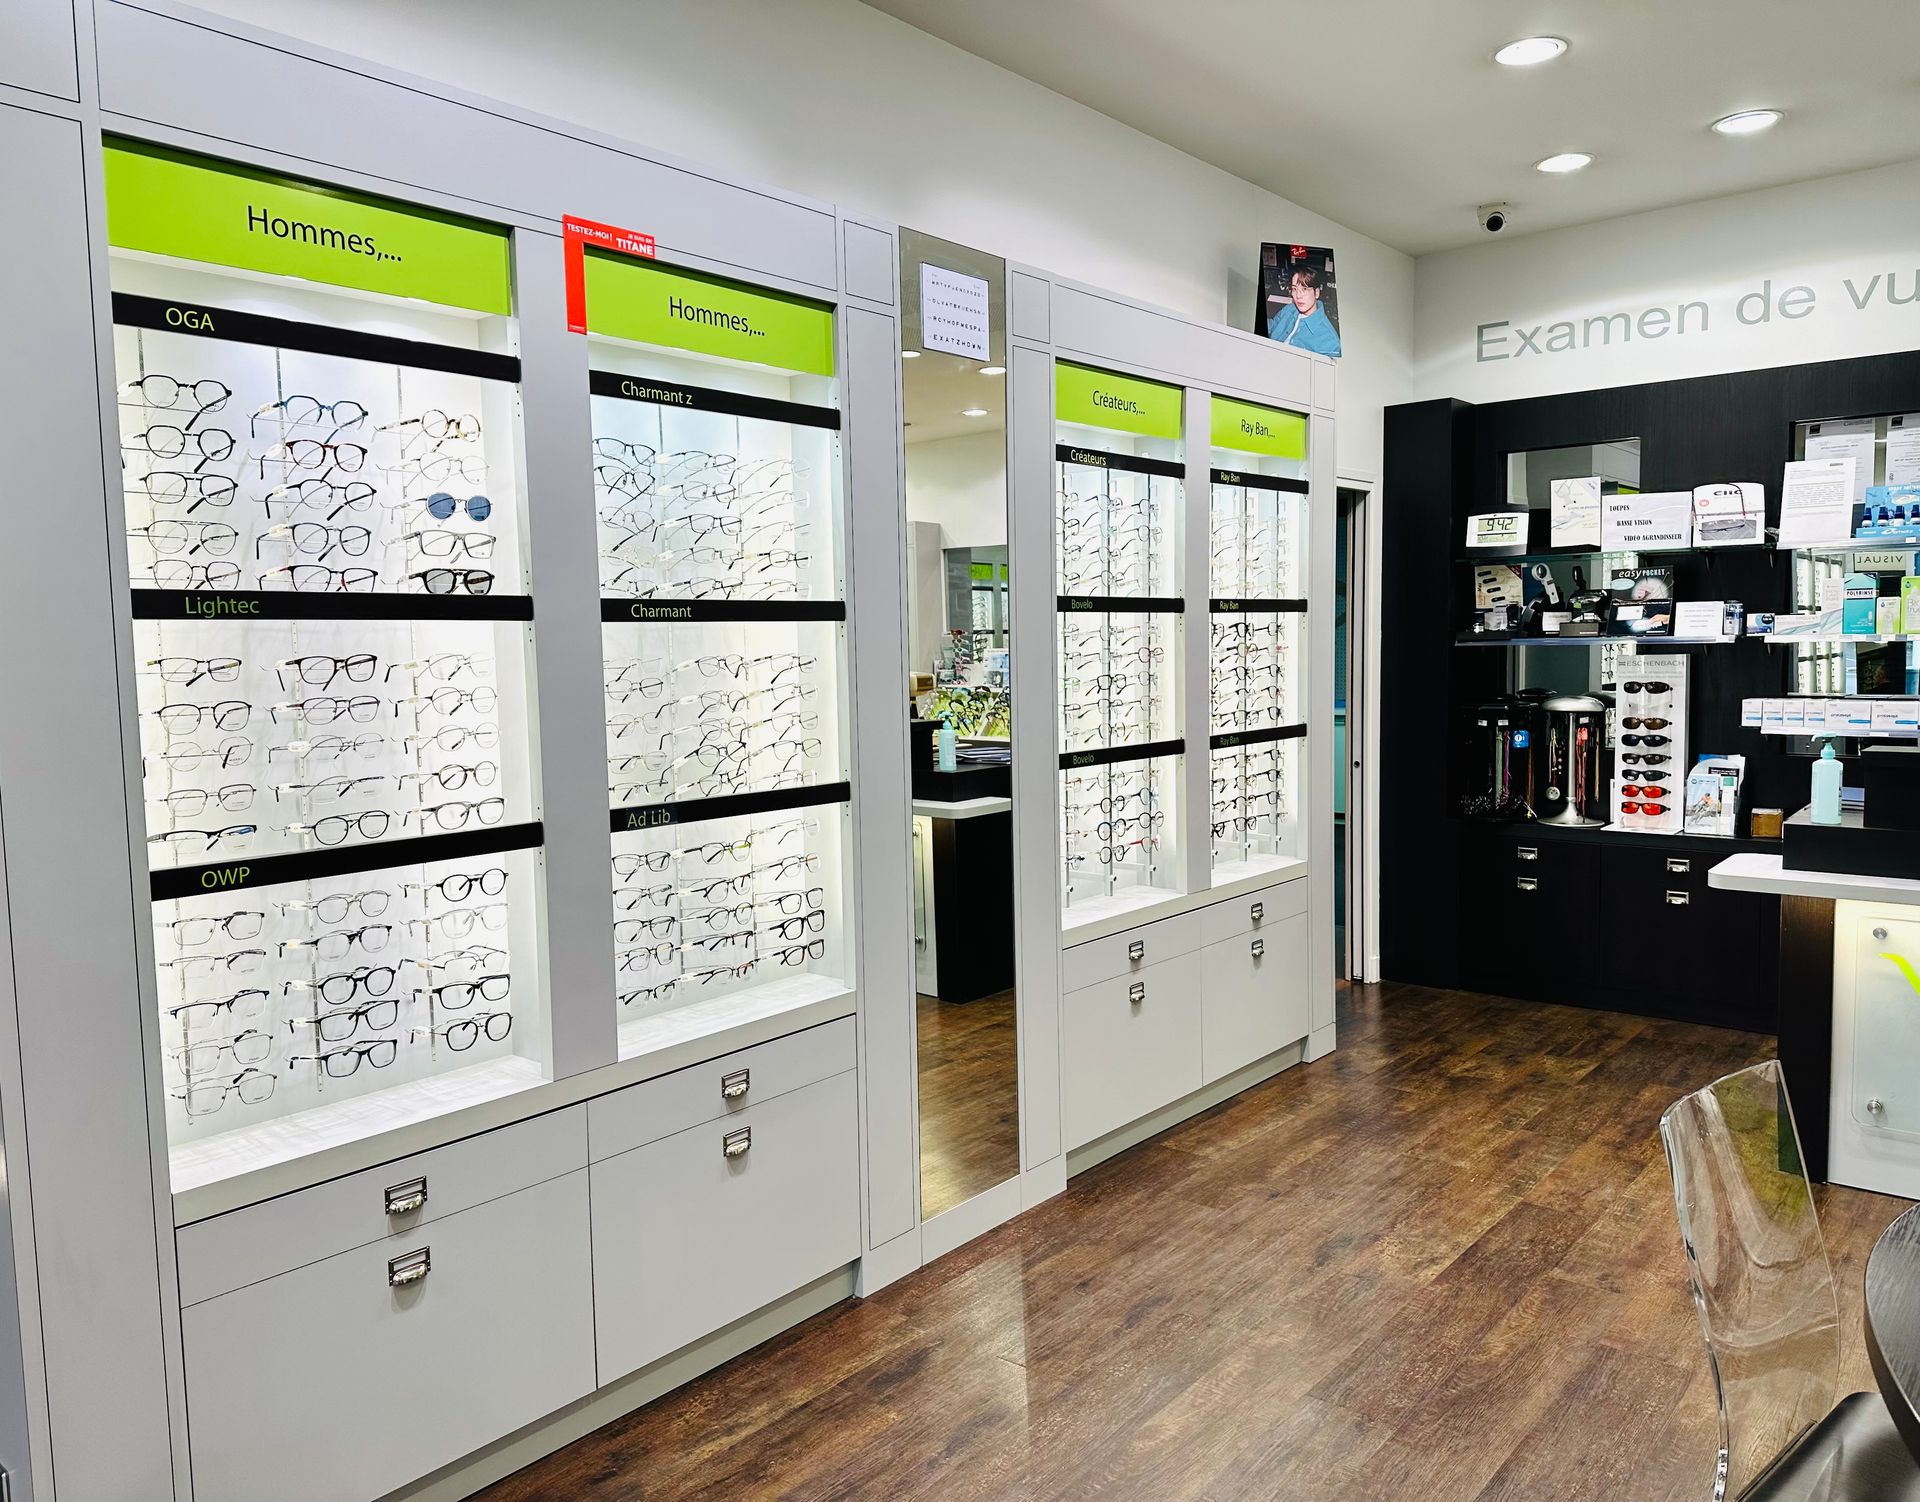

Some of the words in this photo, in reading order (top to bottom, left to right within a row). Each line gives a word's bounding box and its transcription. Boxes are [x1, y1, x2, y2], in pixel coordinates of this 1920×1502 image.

[247, 205, 402, 262] Hommes,...
[616, 238, 654, 256] TITANE
[166, 308, 215, 332] OGA
[669, 296, 765, 337] Hommes,...
[1476, 301, 1710, 363] Examen
[1735, 279, 1816, 326] de
[1842, 269, 1920, 310] vu
[621, 381, 683, 404] Charmant
[686, 393, 693, 405] z
[1241, 419, 1254, 438] Ray
[1070, 449, 1107, 466] Créateurs
[1220, 471, 1230, 483] Ray
[1230, 473, 1241, 483] Ban
[1619, 569, 1642, 580] easy
[1642, 568, 1666, 577] POCKET
[185, 596, 260, 618] Lightec
[631, 603, 692, 618] Charmant
[1071, 599, 1093, 609] Bovelo
[1219, 601, 1230, 611] Ray
[1230, 601, 1240, 610] Ban
[1220, 737, 1230, 747] Ray
[1230, 736, 1240, 745] Ban
[1072, 754, 1094, 765] Bovelo
[627, 813, 647, 828] Ad
[651, 809, 671, 825] Lib
[201, 866, 250, 888] OWP
